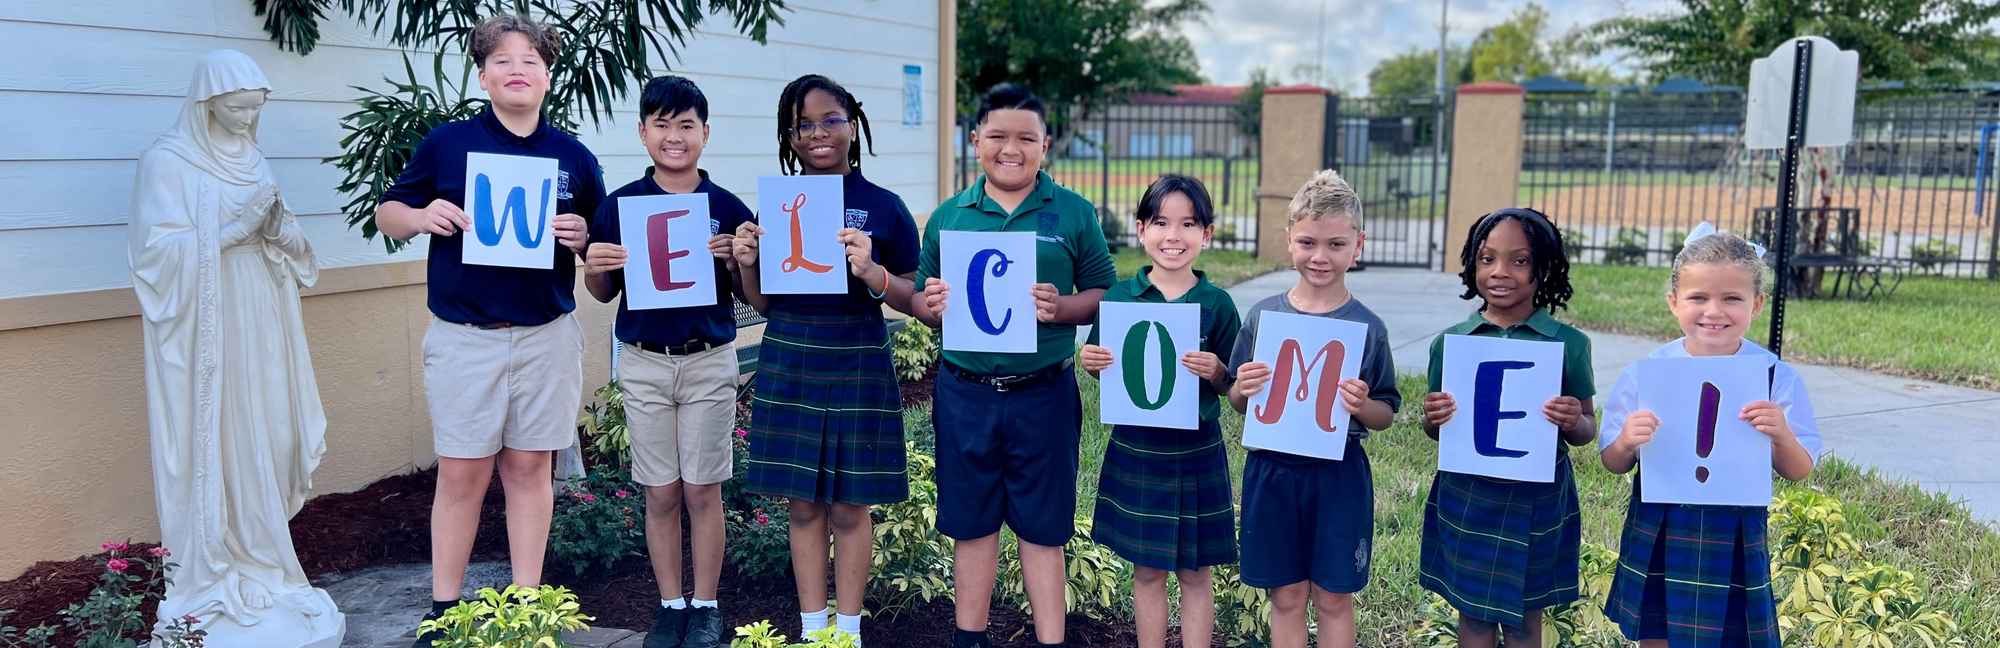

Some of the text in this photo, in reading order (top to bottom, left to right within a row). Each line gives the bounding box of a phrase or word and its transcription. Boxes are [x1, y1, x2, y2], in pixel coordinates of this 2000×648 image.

[474, 173, 551, 249] W
[647, 209, 696, 291] E
[782, 193, 833, 273] L
[966, 249, 1014, 336] C
[1122, 320, 1177, 410] O
[1255, 339, 1345, 432] M
[1473, 361, 1535, 458] E
[1695, 382, 1721, 483] !
